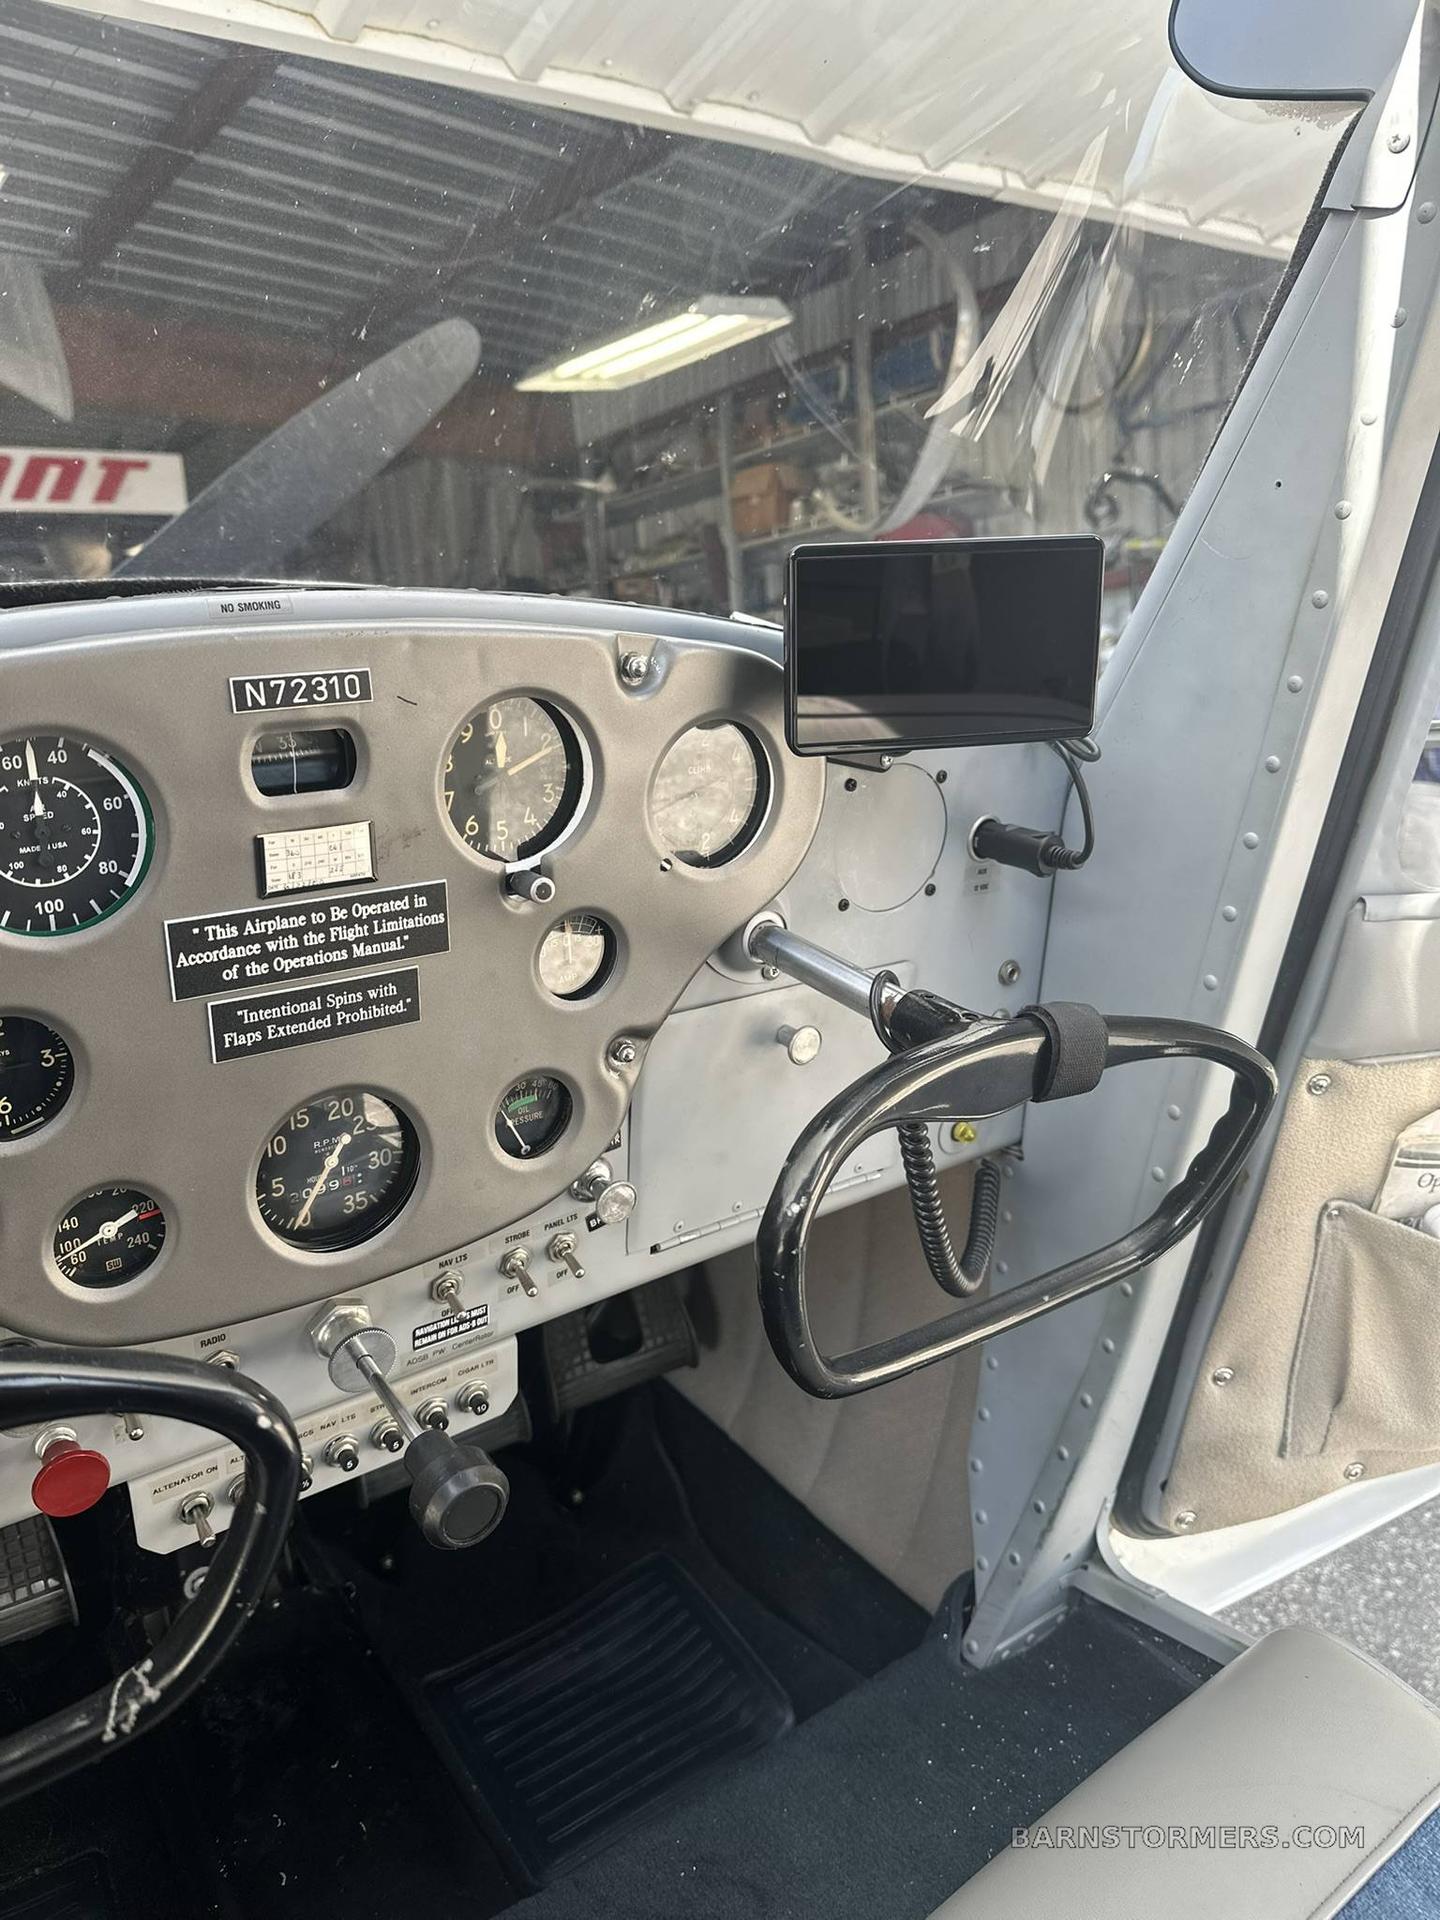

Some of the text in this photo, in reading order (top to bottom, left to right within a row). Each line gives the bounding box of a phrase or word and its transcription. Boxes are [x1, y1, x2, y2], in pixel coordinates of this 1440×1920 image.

[0, 455, 150, 503] NT
[220, 600, 281, 613] NO SMOKING
[244, 673, 361, 707] N72310
[489, 709, 502, 729] 0
[461, 723, 473, 743] 9
[47, 750, 67, 764] 40
[17, 777, 49, 787] KNTS
[543, 783, 554, 803] 3
[103, 796, 122, 811] 60
[23, 811, 54, 822] SPED
[524, 807, 537, 824] 4
[81, 827, 91, 835] 60
[465, 815, 479, 835] 6
[496, 820, 508, 840] 5
[19, 841, 68, 855] MADE USA
[8, 861, 24, 870] 100
[57, 864, 67, 873] 80
[98, 860, 117, 875] 80
[35, 899, 64, 914] 100
[243, 912, 307, 936] Airplane
[311, 911, 326, 924] to
[330, 906, 349, 922] Be
[352, 896, 410, 920] Operated
[413, 894, 427, 909] in
[176, 913, 445, 968] Accordance with the Flight Limitations
[222, 935, 409, 981] of the Operations Manual."
[237, 983, 397, 1024] "Intentional Spins with
[223, 998, 412, 1048] Flaps Extended Prohibited."
[41, 1049, 55, 1067] 3
[328, 1098, 353, 1121] 20
[518, 1106, 529, 1115] OIL
[289, 1108, 309, 1130] 15
[509, 1111, 543, 1126] RESSURE
[267, 1136, 287, 1157] 10
[368, 1148, 392, 1170] 30
[271, 1178, 285, 1197] 5
[132, 1200, 154, 1213] 220
[343, 1190, 368, 1214] 35
[544, 1213, 578, 1231] PANEL LTS
[127, 1232, 150, 1249] 240
[505, 1229, 530, 1244] STROBE
[59, 1238, 81, 1254] 100
[70, 1251, 87, 1265] 60
[439, 1253, 468, 1269] NAV LTS
[556, 1269, 568, 1279] OFF
[507, 1284, 519, 1295] OFF
[415, 1317, 450, 1337] NAVIGATION
[471, 1306, 487, 1316] MUST
[200, 1334, 226, 1348] RADIO
[414, 1334, 437, 1349] REMAIN
[438, 1330, 446, 1340] ON
[447, 1326, 458, 1336] FOR
[477, 1316, 488, 1326] OUT
[458, 1363, 479, 1376] CIGAR
[411, 1376, 447, 1395] INTERCOM
[477, 1403, 487, 1413] 10
[320, 1414, 356, 1431] NAV LTS
[152, 1465, 218, 1495] ALTENATOR ON
